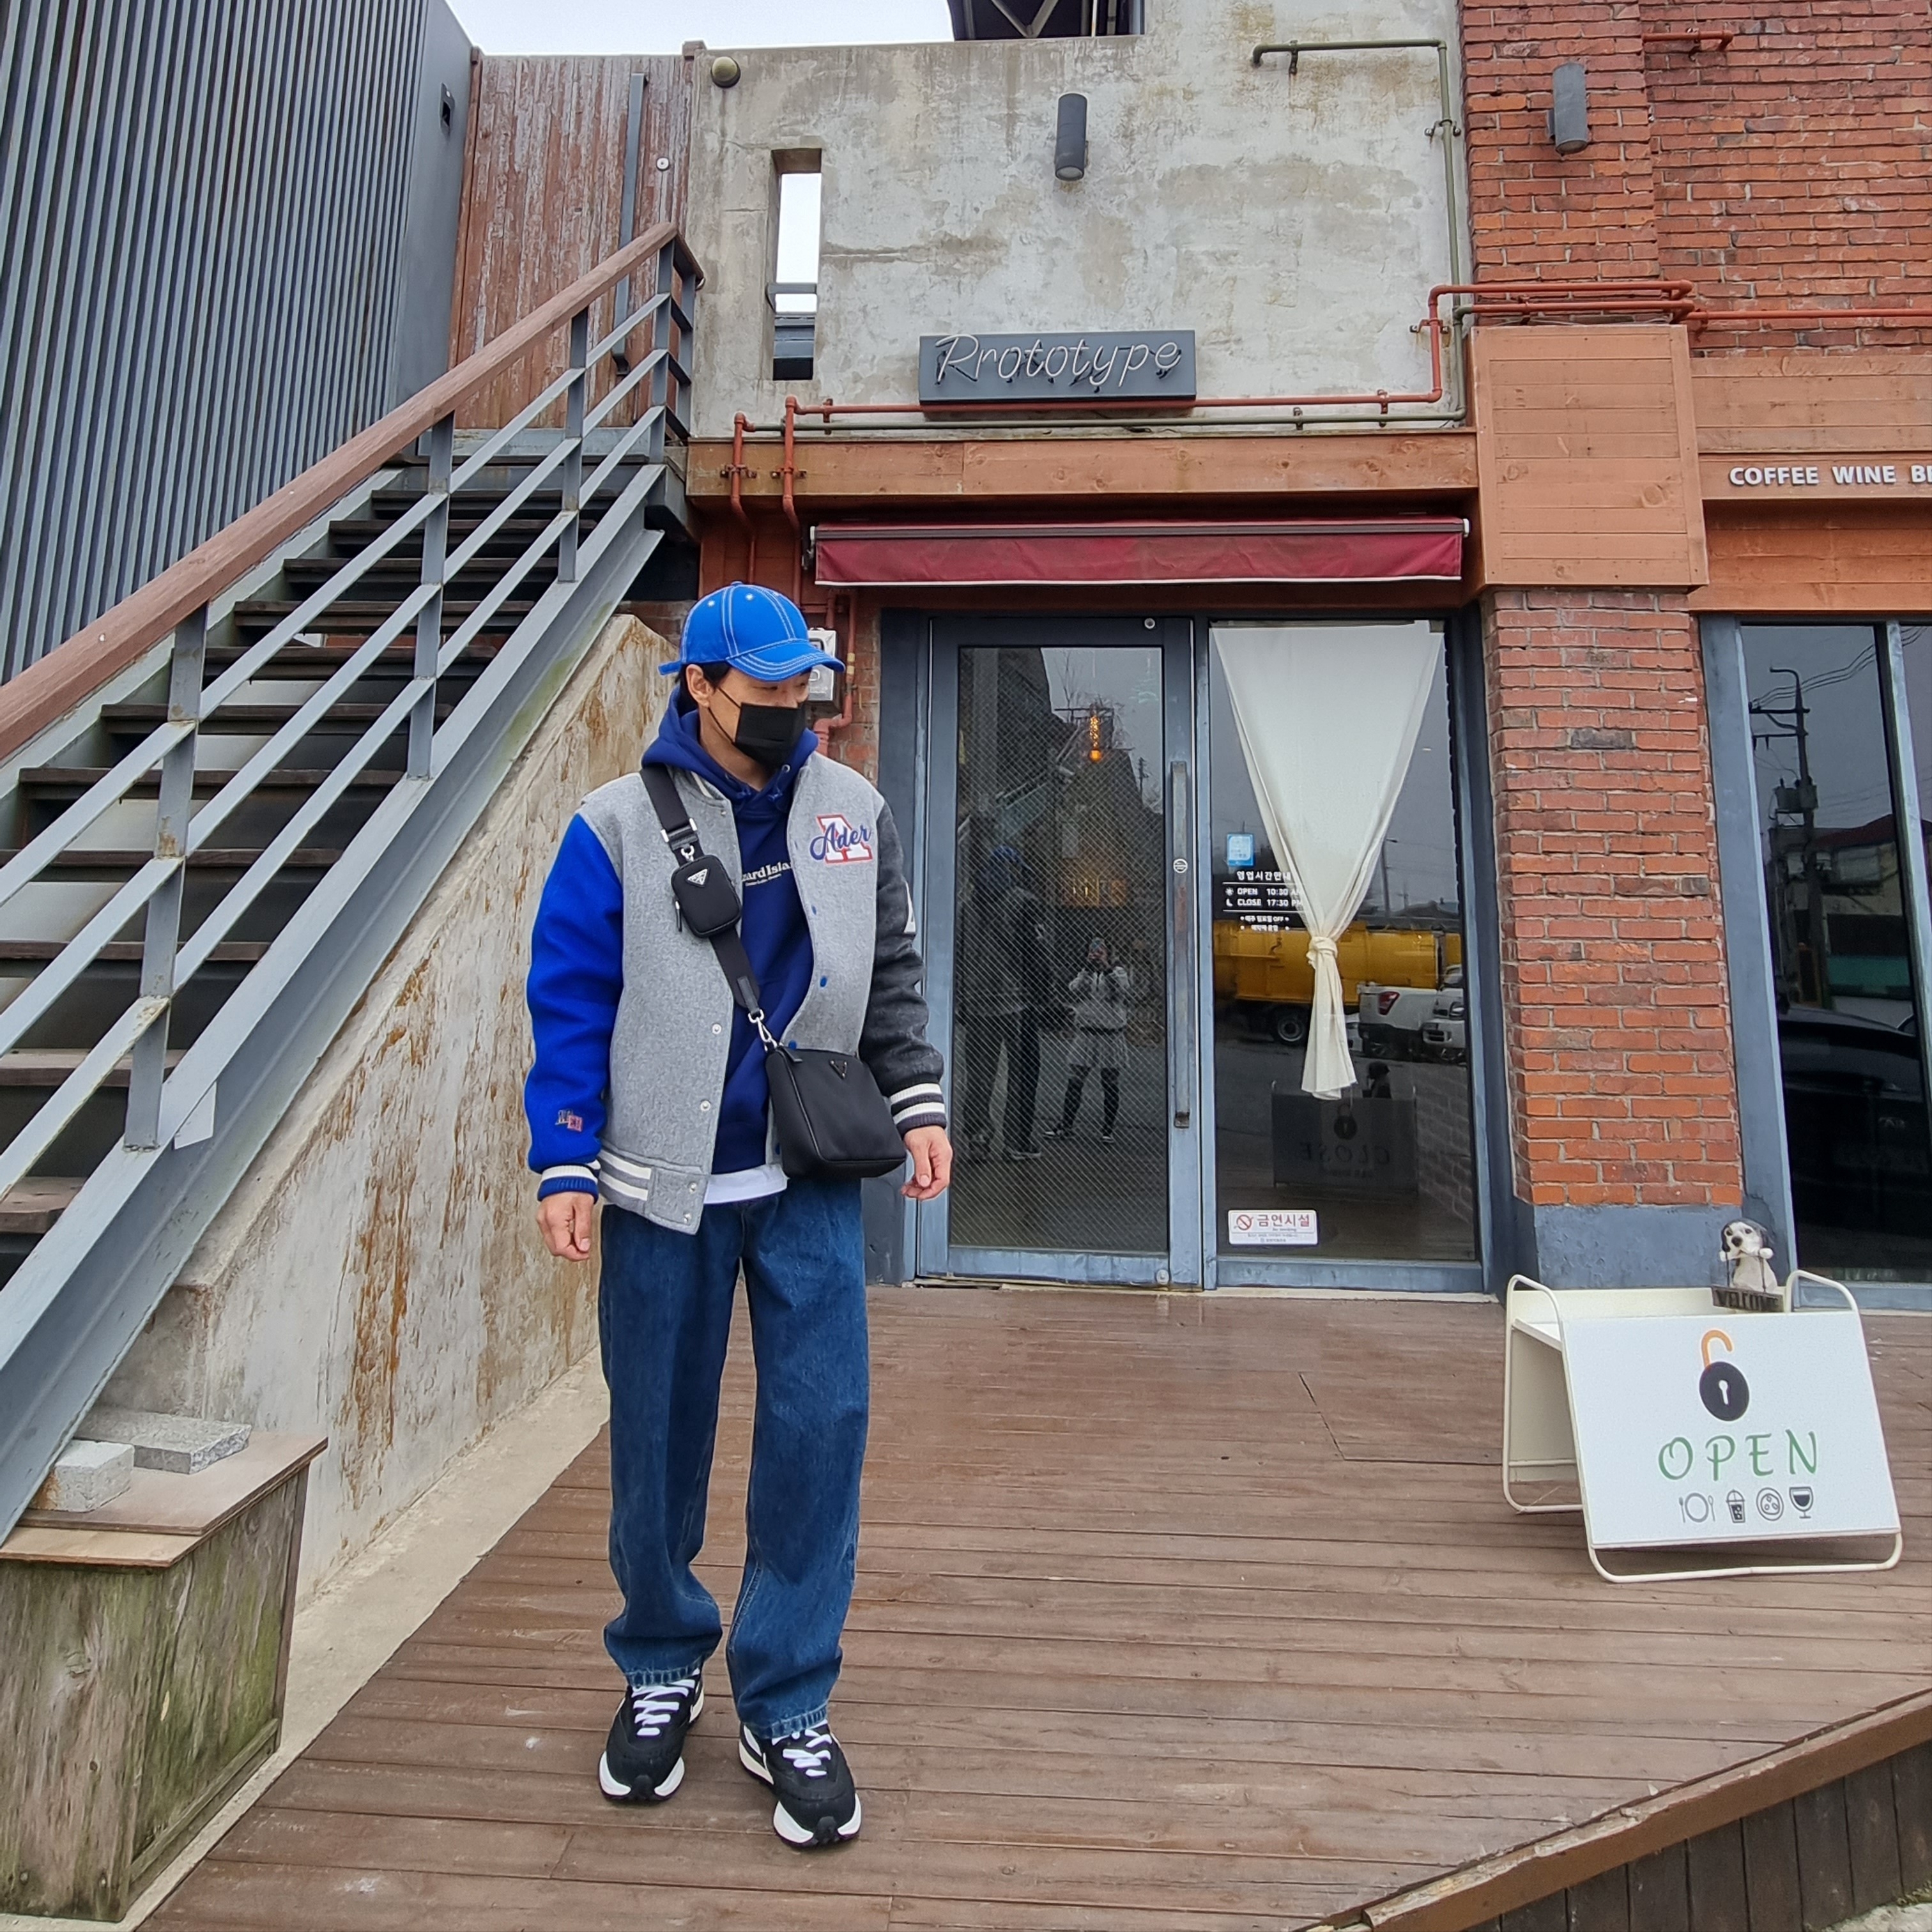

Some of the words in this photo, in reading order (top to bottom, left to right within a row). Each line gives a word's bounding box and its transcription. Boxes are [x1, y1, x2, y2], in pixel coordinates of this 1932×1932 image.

[1729, 467, 1819, 486] COFFEE
[1832, 465, 1896, 484] WINE
[809, 822, 871, 861] Ader
[1237, 898, 1262, 907] CLOSE
[1257, 1214, 1310, 1227] 금연시설
[1658, 1429, 1818, 1482] OPEN
